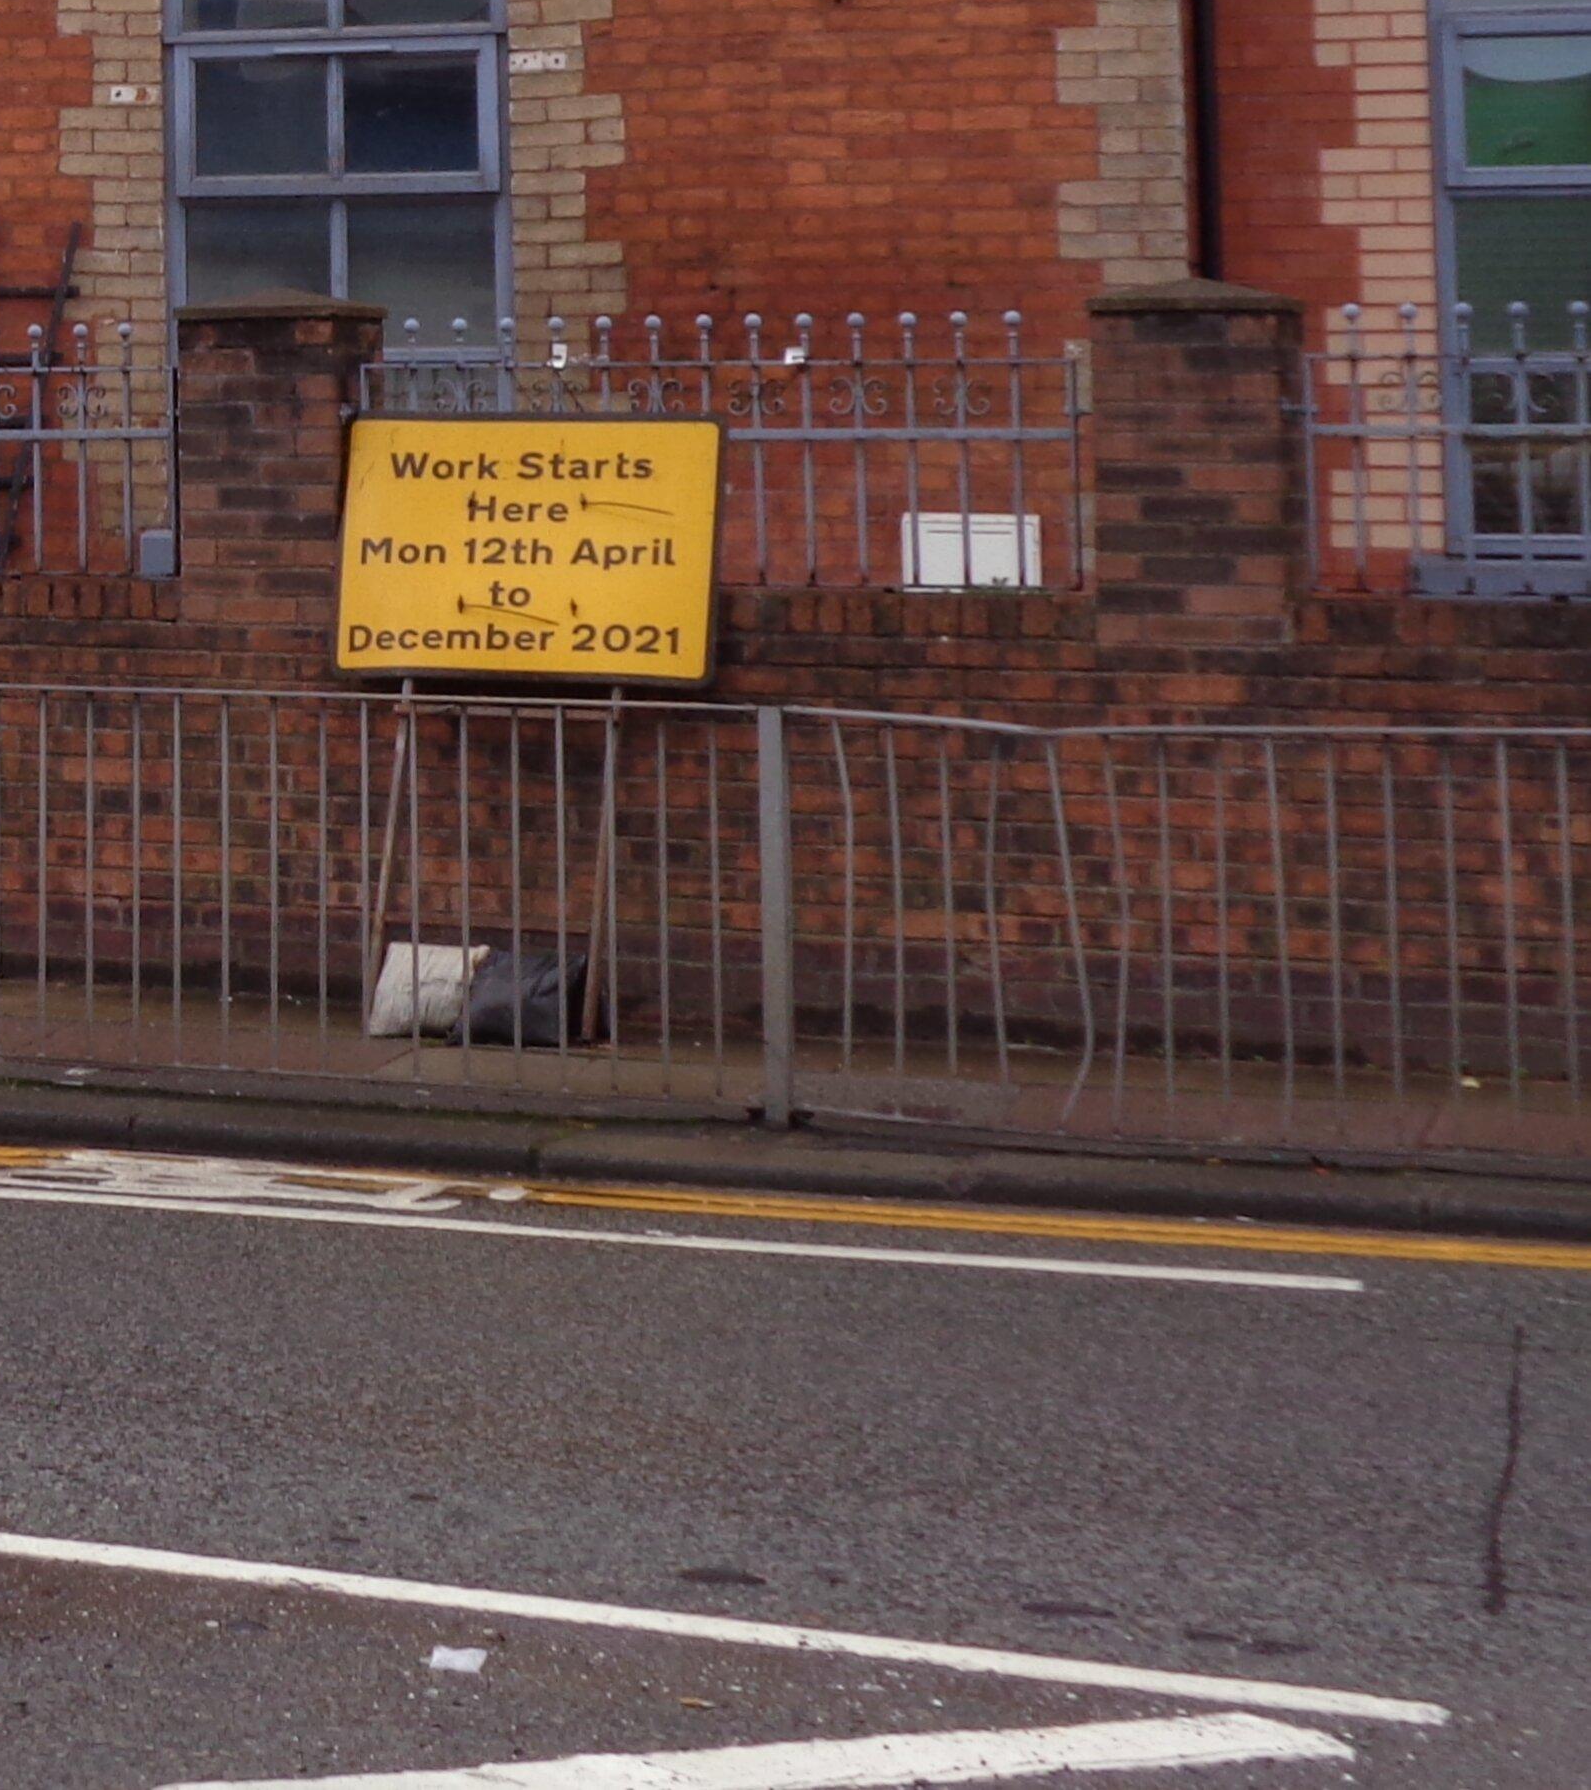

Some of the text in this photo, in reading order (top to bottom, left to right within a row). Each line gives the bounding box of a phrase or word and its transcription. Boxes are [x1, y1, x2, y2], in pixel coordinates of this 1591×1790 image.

[391, 452, 654, 480] Work Starts
[467, 495, 569, 523] Here
[360, 537, 676, 570] Mon 12th April
[489, 580, 531, 607] to
[348, 623, 681, 655] December 2021
